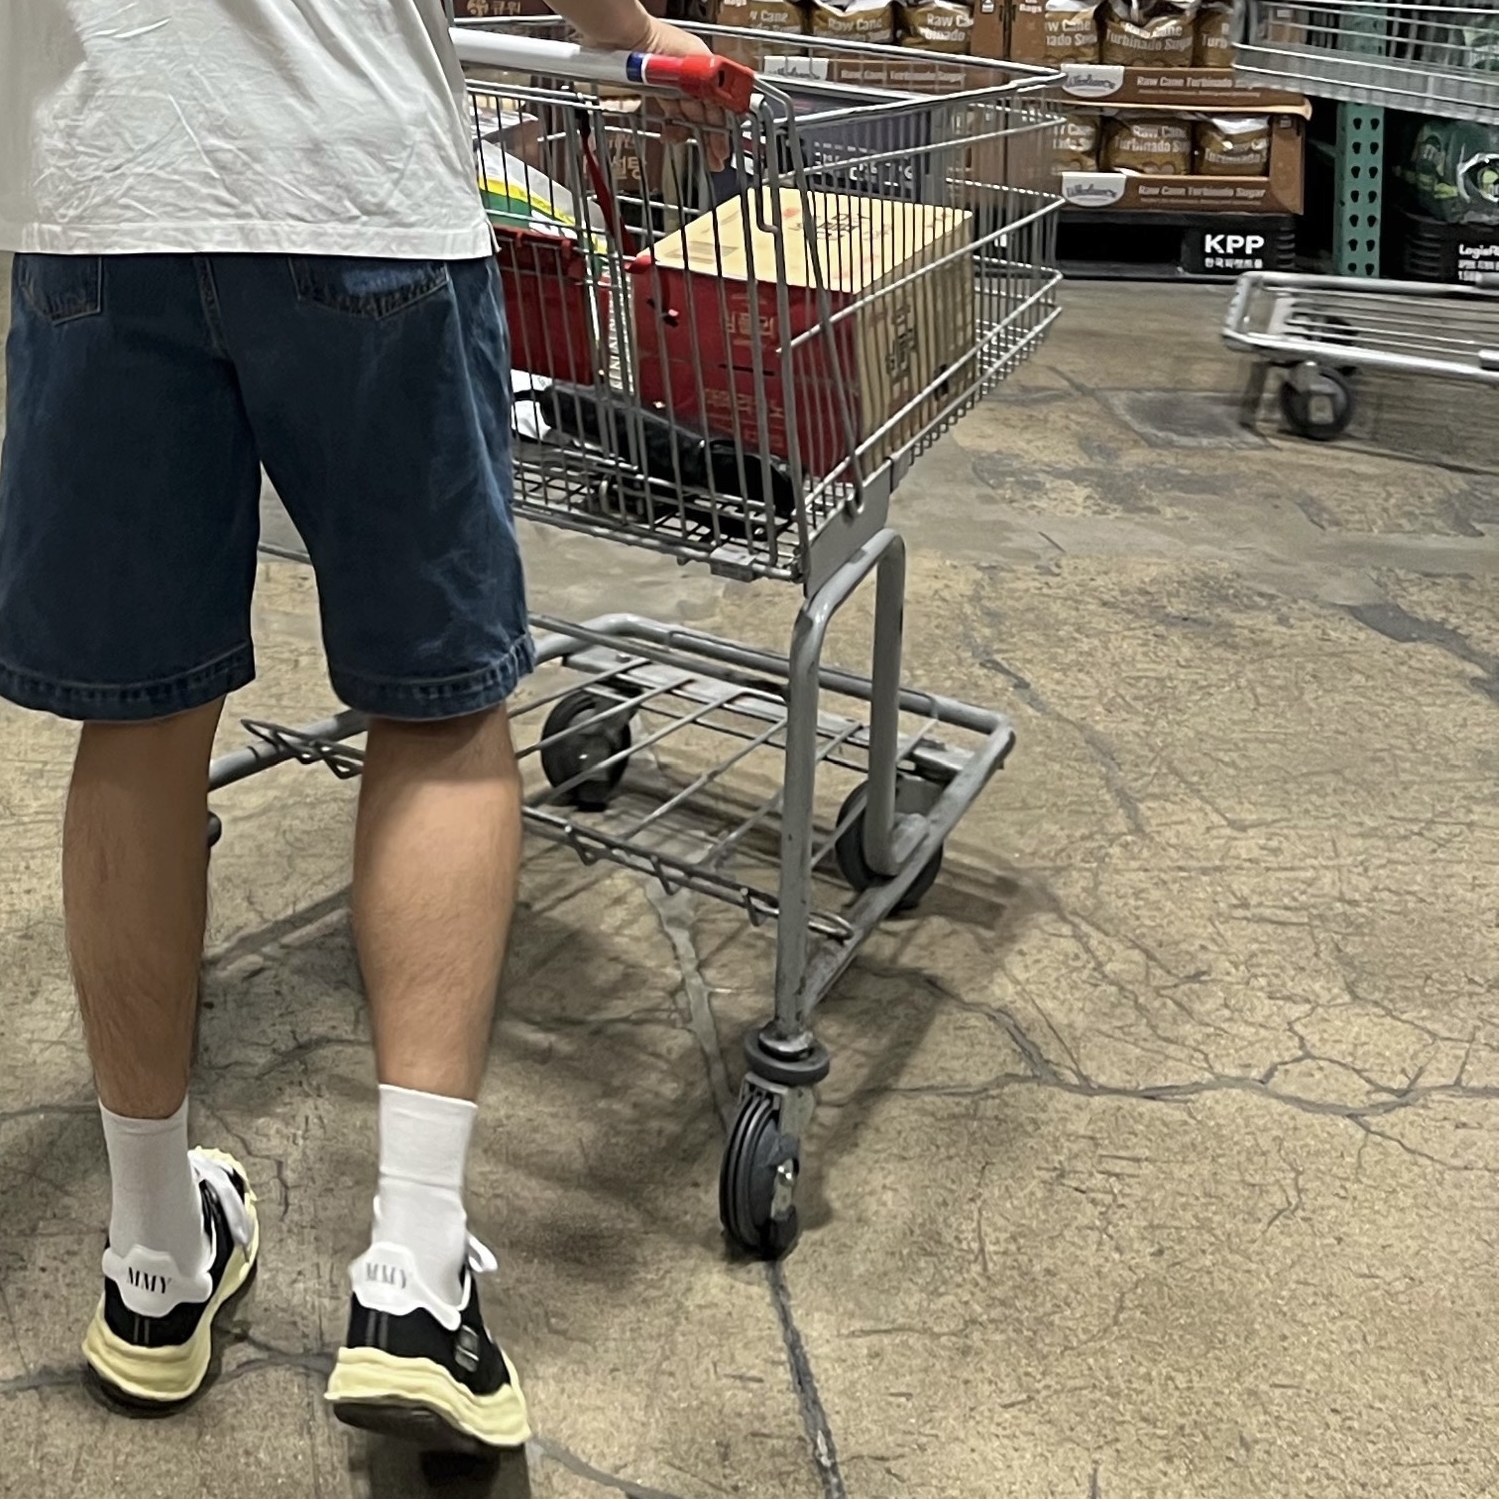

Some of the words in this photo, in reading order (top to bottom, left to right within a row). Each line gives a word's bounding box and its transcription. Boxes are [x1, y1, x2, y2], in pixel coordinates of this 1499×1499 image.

[1019, 3, 1042, 13] Bags
[761, 11, 788, 23] Cane
[927, 13, 952, 27] Raw
[828, 18, 854, 31] Raw
[856, 18, 882, 30] Cane
[1137, 76, 1157, 86] Raw
[1159, 77, 1183, 87] Cane
[1186, 77, 1233, 88] Turbinado
[1139, 185, 1160, 195] Raw
[1161, 186, 1186, 196] Cane
[1188, 186, 1234, 197] Turbinado
[1236, 187, 1266, 198] Sugar
[1204, 234, 1265, 254] KPP
[126, 1266, 172, 1294] MMY
[365, 1262, 408, 1289] MMY
